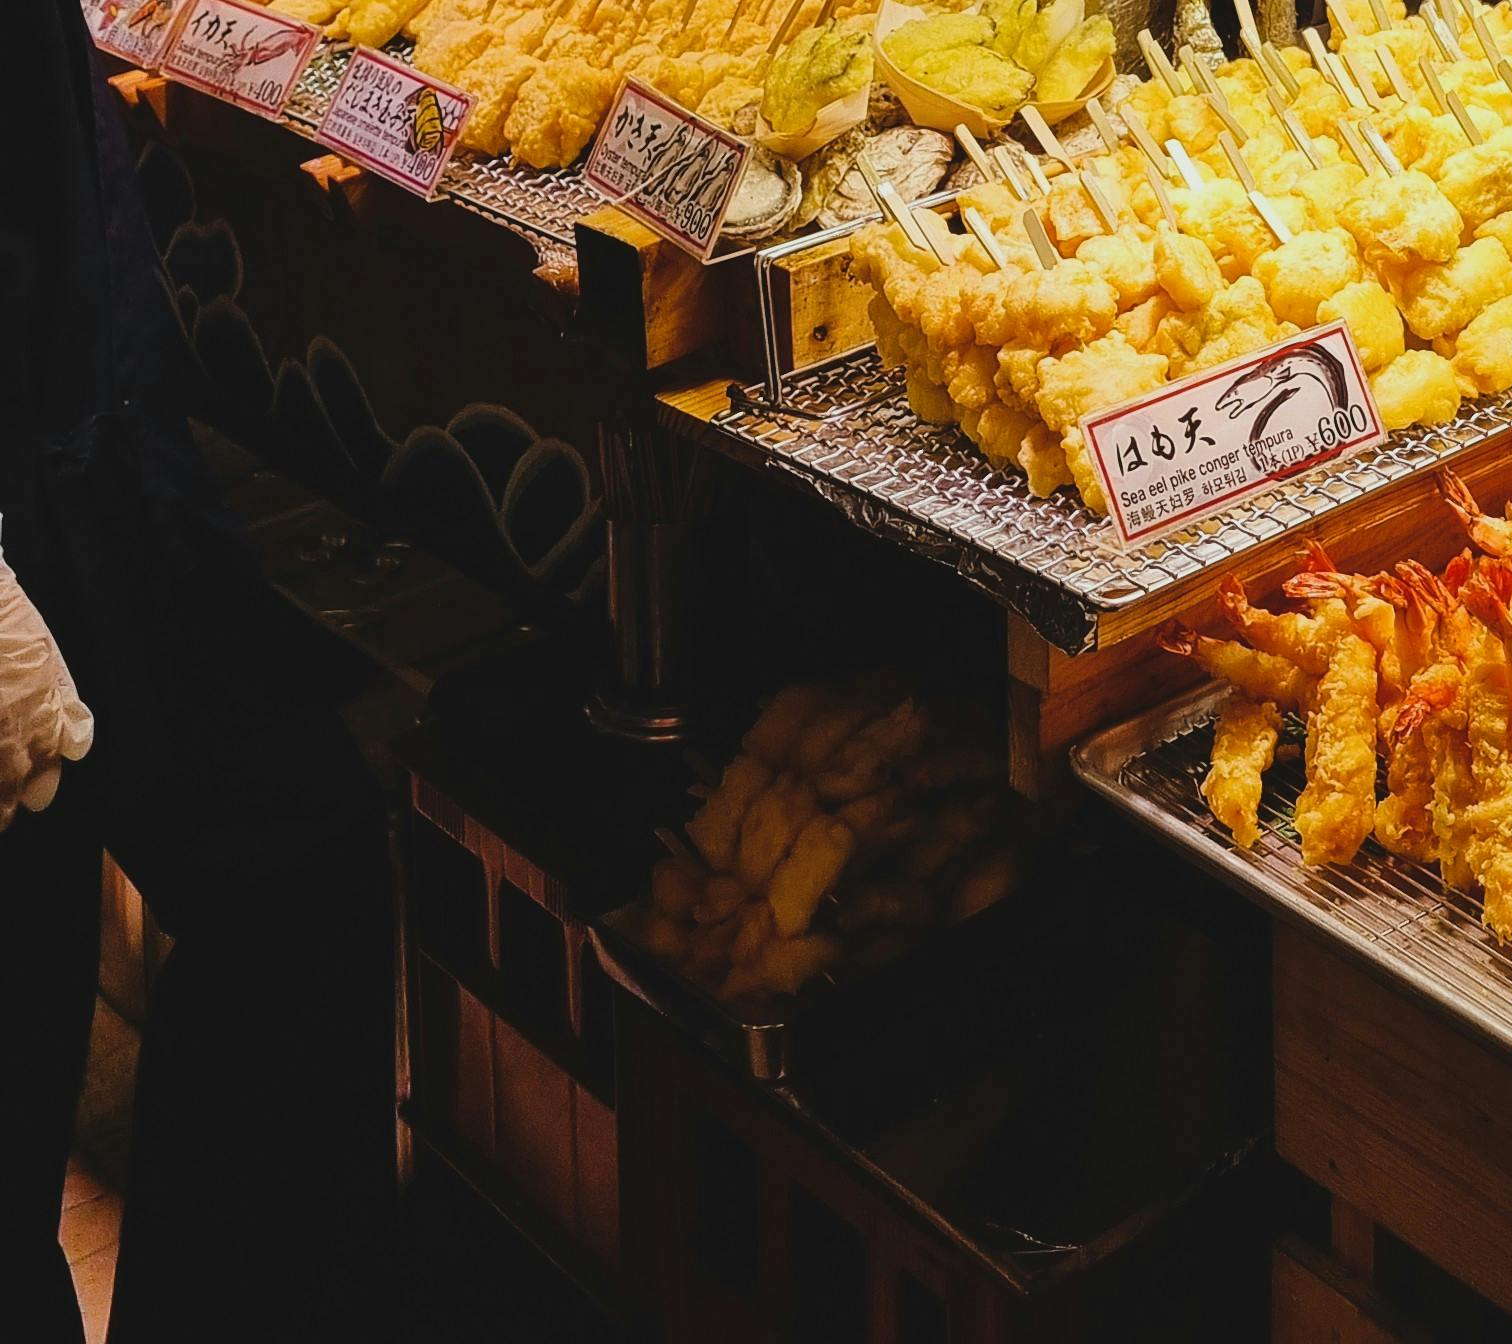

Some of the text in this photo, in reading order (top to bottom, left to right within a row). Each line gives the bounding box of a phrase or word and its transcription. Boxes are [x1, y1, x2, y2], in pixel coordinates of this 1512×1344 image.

[1116, 406, 1216, 477] はも天
[1307, 404, 1368, 455] ¥600
[1120, 428, 1294, 509] Sea eel pike conger tempura
[1201, 468, 1248, 496] 하모튀김
